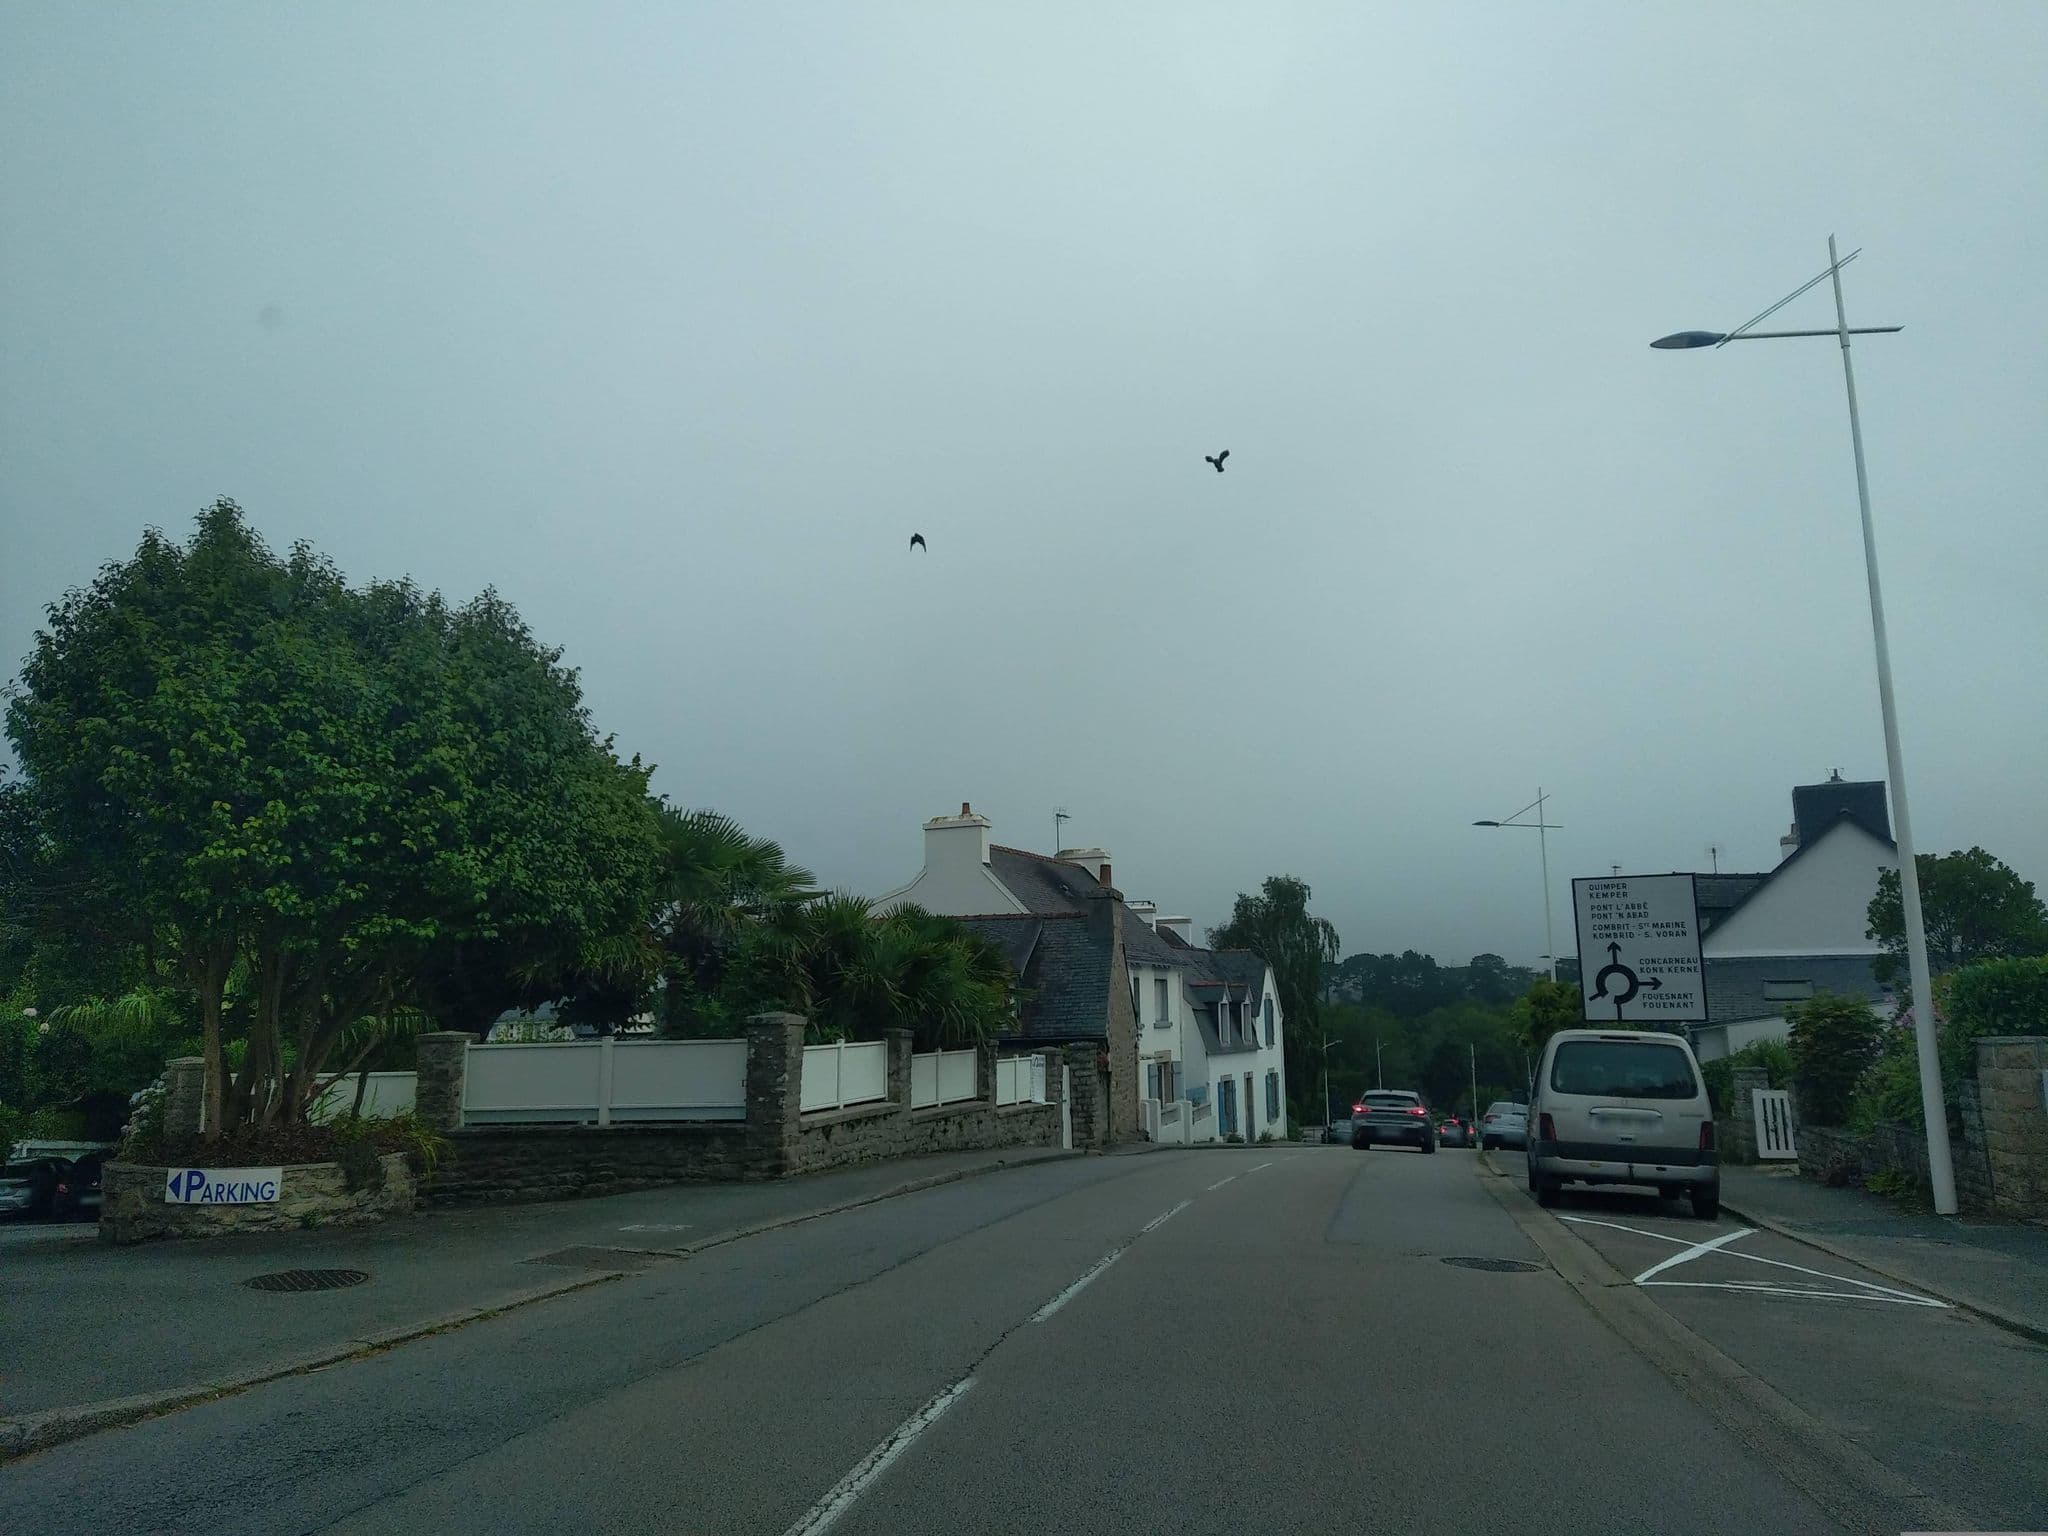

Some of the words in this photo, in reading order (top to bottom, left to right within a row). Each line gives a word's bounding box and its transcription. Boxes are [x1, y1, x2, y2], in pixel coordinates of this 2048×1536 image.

[1588, 883, 1627, 891] QUIMPER
[1589, 891, 1628, 899] KEMPER
[1590, 904, 1613, 912] PONT
[1591, 912, 1613, 920] PONT
[1592, 923, 1630, 931] COMBRIT
[1652, 921, 1687, 929] MARINE
[1593, 931, 1635, 939] KOMBRID
[1656, 930, 1687, 938] VORAN
[1639, 957, 1698, 965] CONCARNEAU
[1639, 966, 1665, 974] KONK
[1642, 992, 1694, 1000] FOUESNANT
[1643, 1001, 1695, 1009] FOUENANT
